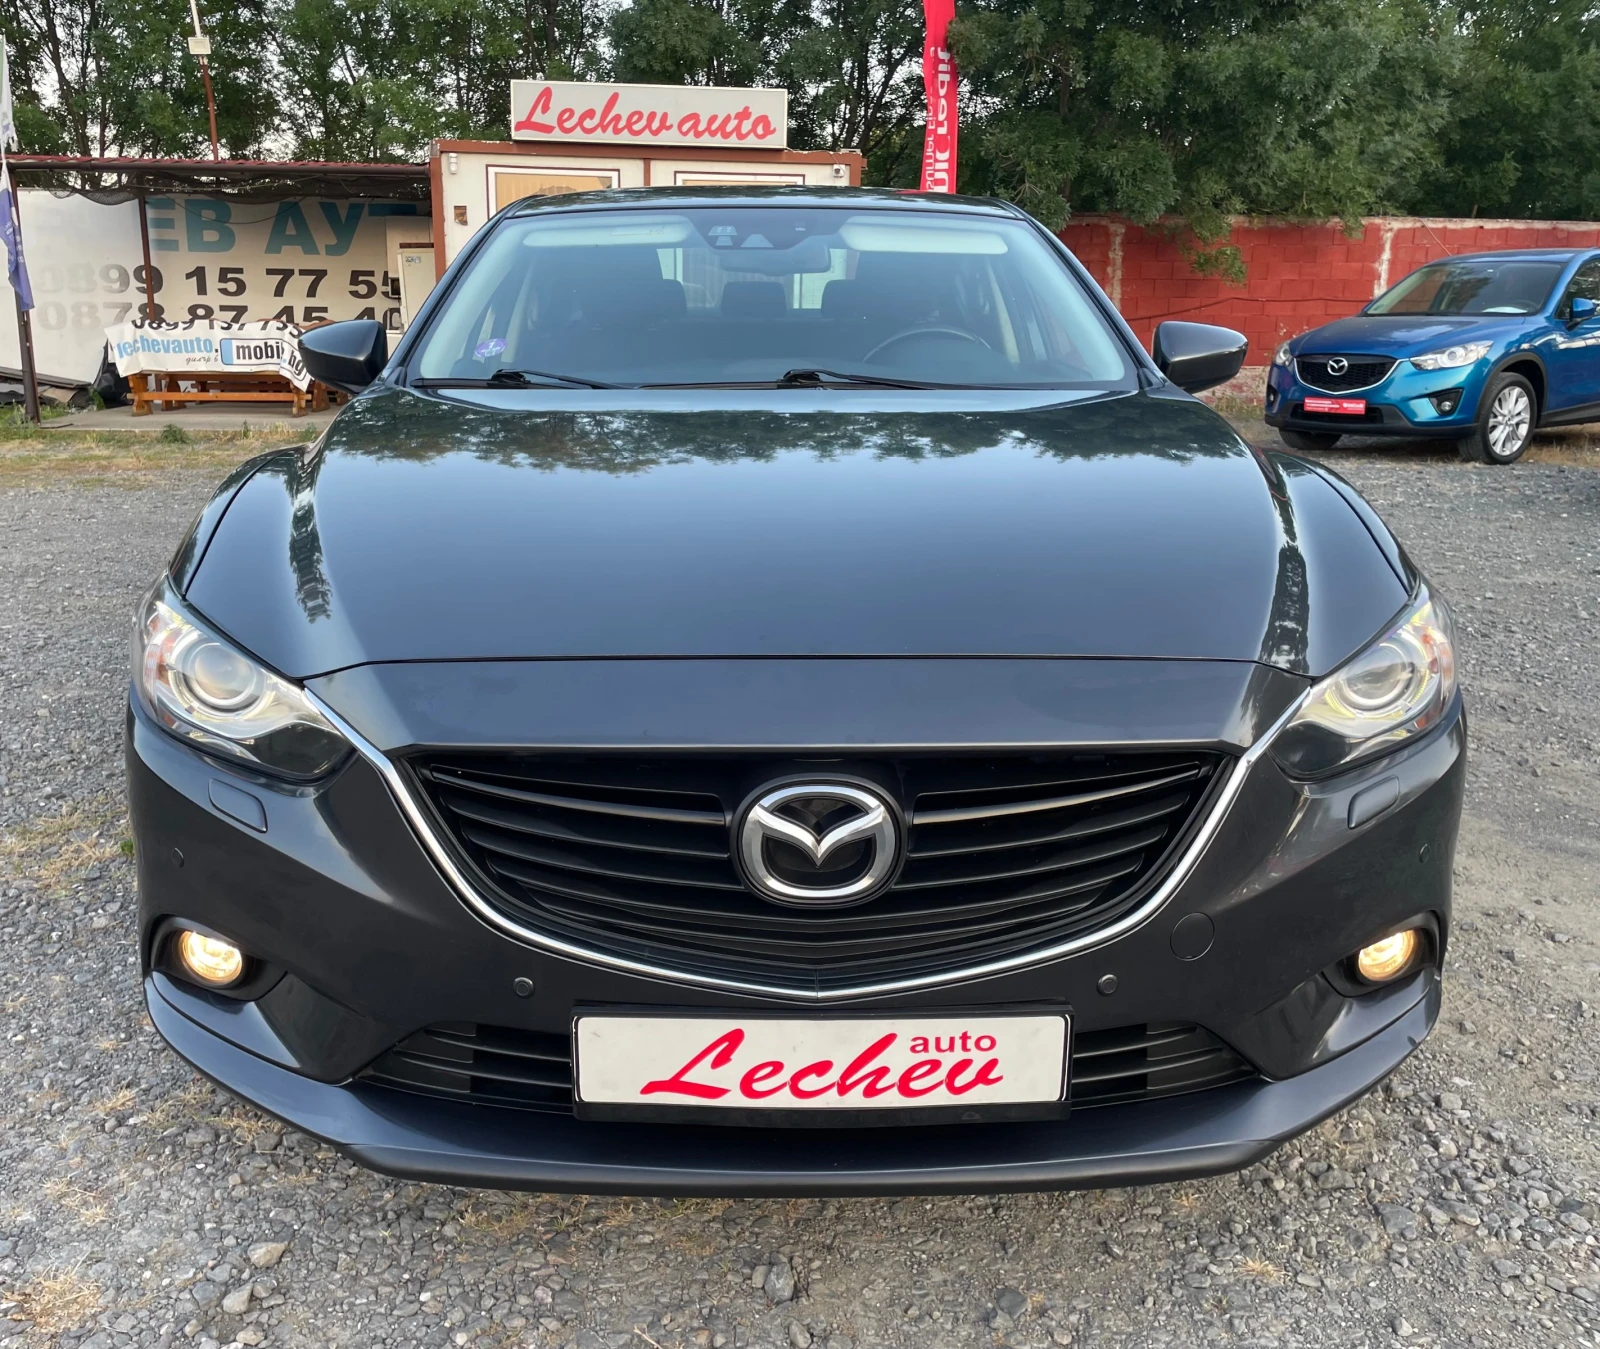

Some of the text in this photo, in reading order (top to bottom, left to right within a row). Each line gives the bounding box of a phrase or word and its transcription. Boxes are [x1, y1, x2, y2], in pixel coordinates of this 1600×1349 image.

[514, 86, 777, 141] Lechev auto
[185, 265, 247, 297] 15
[265, 268, 328, 298] 77
[639, 1028, 1003, 1100] Lechev
[909, 1031, 997, 1053] auto
